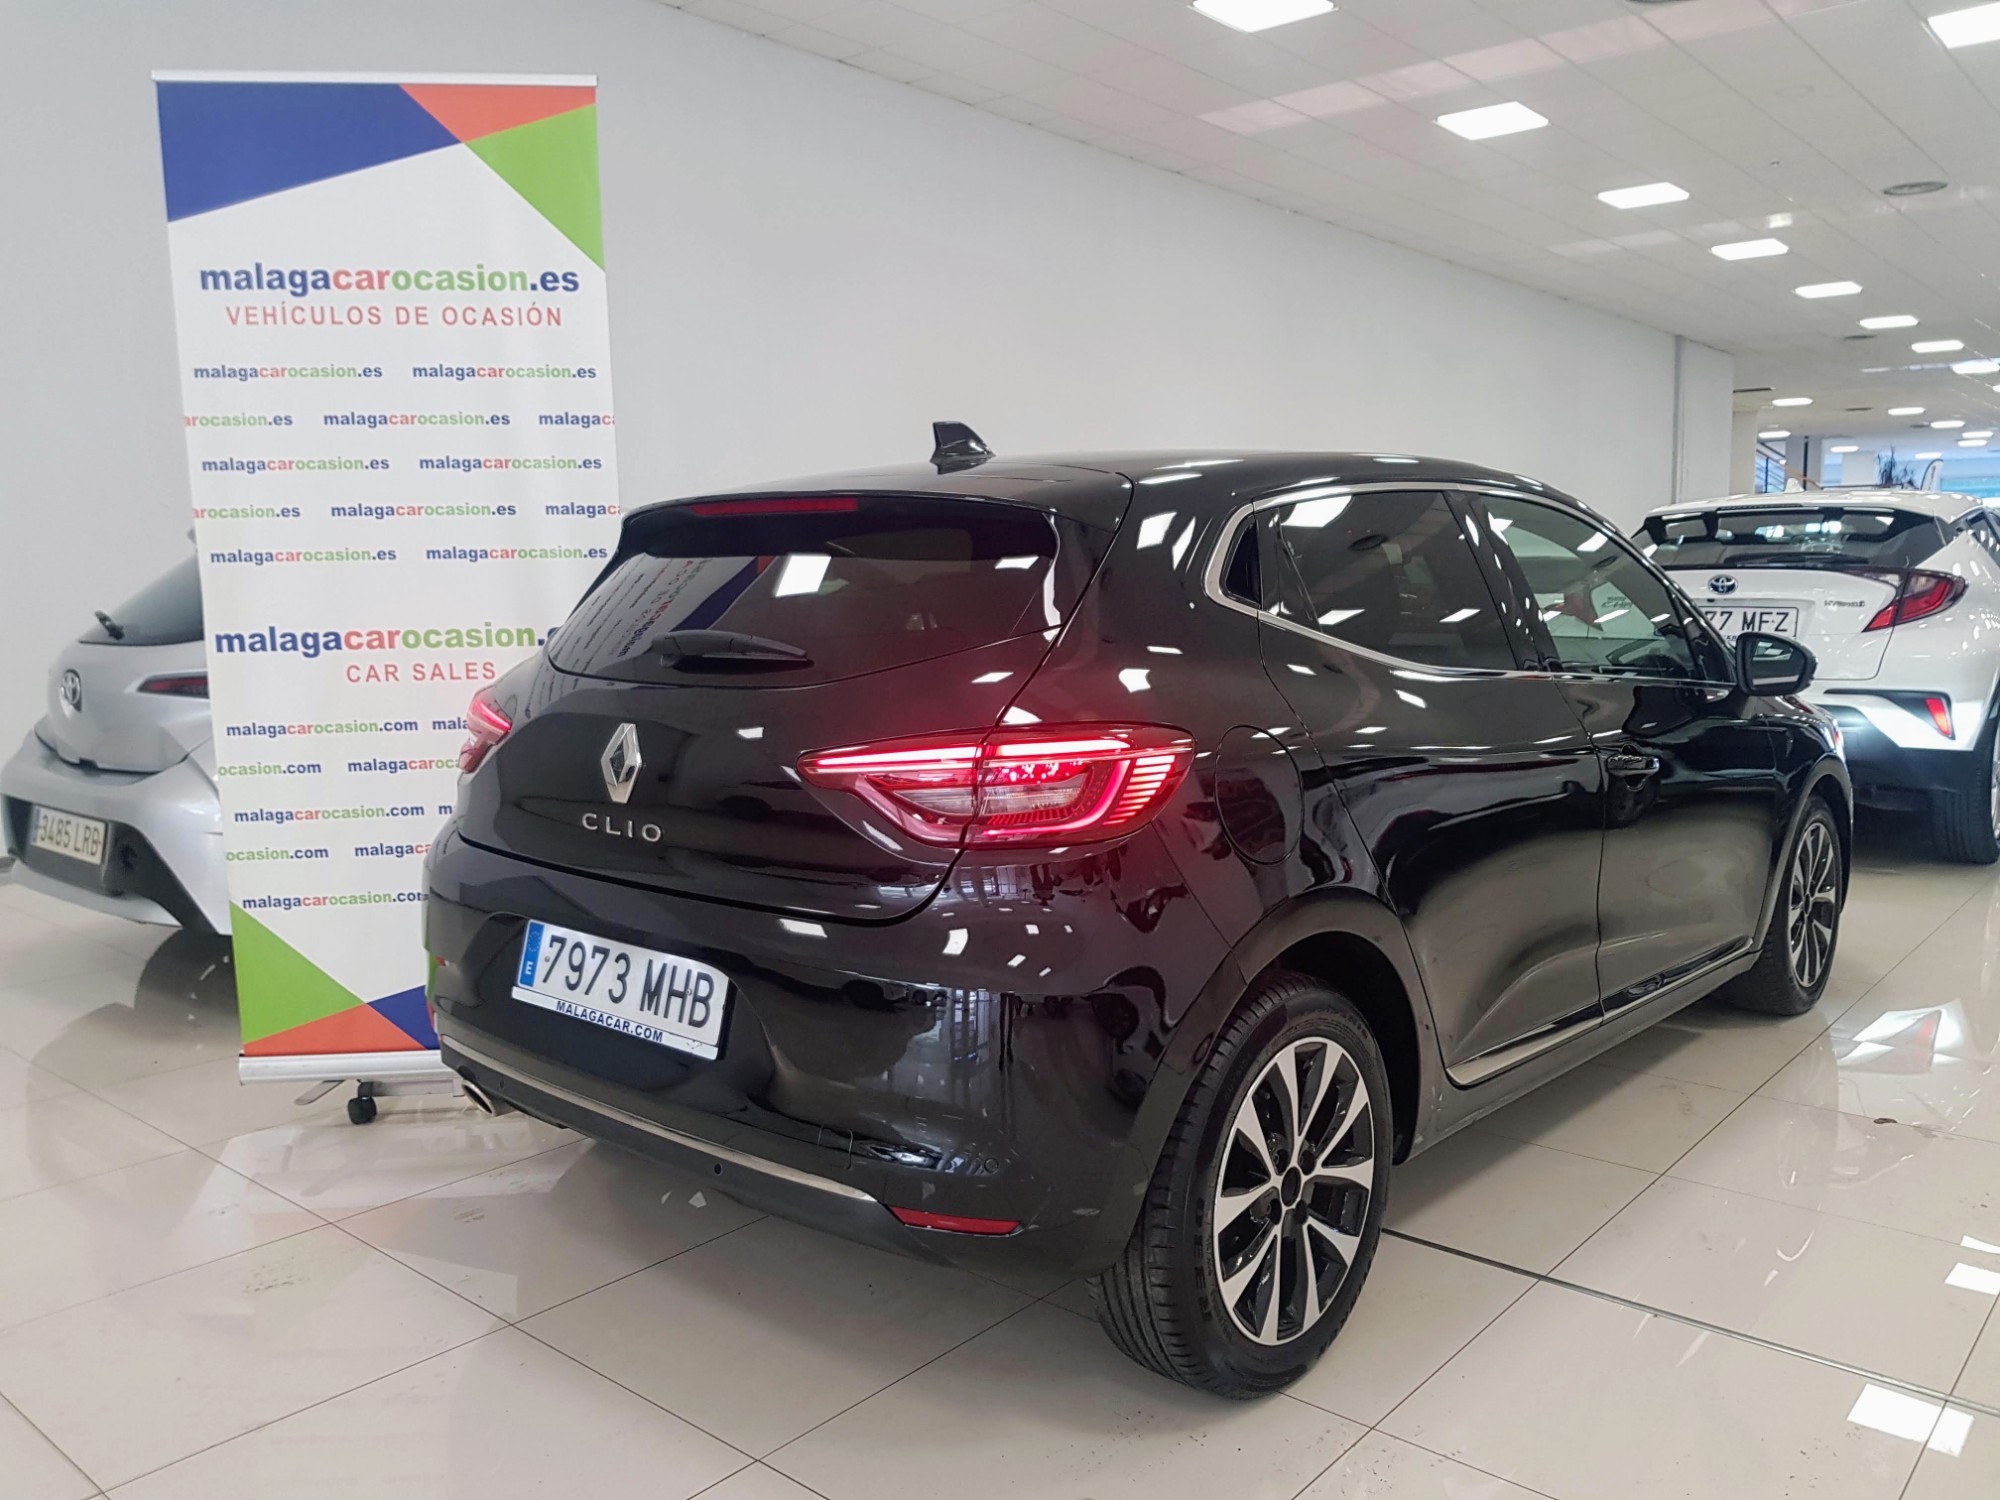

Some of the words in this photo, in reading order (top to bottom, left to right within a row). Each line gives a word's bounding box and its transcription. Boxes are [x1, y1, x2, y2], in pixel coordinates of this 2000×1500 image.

[200, 262, 579, 297] malagacarocasion.es
[226, 301, 382, 326] VEHÍCULOS
[396, 307, 429, 326] DE
[442, 302, 562, 327] OCASIÓN
[194, 364, 383, 381] malagacarocasion.es
[412, 364, 597, 381] malagacarocasion.es
[323, 412, 511, 429] malagacarocasion.es
[202, 457, 390, 474] malagacarocasion.es
[419, 456, 602, 473] malagacarocasion.es
[330, 503, 517, 520] malagacarocasion.es
[210, 548, 397, 566] malagacarocasion.es
[426, 546, 608, 564] malagacarocasion.es
[1741, 611, 1790, 633] MFZ
[346, 664, 399, 683] CAR
[412, 662, 497, 681] SALES
[226, 720, 418, 738] malagacarocasion.com
[218, 762, 321, 776] ocasion.com
[234, 805, 425, 824] malagacarocasion.com
[40, 814, 72, 849] 3485
[74, 823, 101, 856] LRB
[582, 812, 662, 842] CLIO
[226, 847, 329, 862] ocasion.com
[525, 960, 533, 976] E
[542, 934, 631, 1004] 7973
[639, 958, 715, 1029] MHB
[556, 1000, 663, 1043] MALAGACAR.COM
